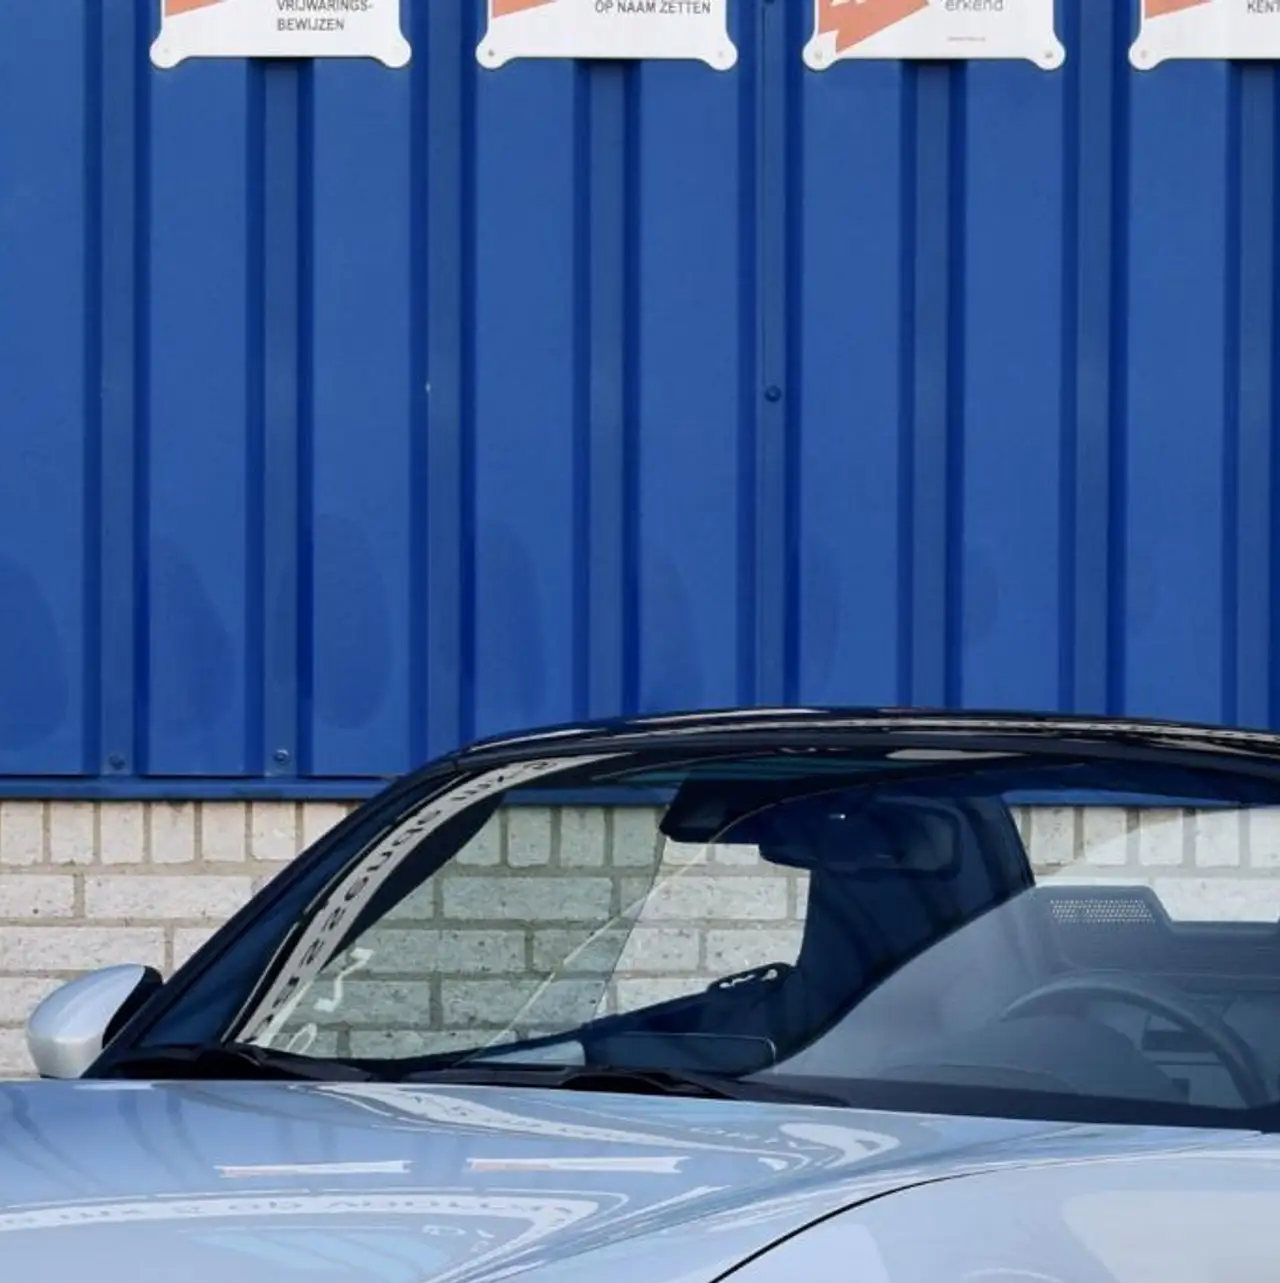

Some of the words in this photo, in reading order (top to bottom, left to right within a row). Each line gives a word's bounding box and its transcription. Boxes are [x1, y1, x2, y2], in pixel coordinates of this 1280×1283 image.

[276, 0, 372, 11] VRIJWARINGS-
[595, 0, 613, 13] OP
[617, 0, 656, 13] NAAM
[659, 1, 711, 14] ZETTEN
[945, 0, 1003, 11] erkend
[277, 18, 344, 31] BEWIJZEN
